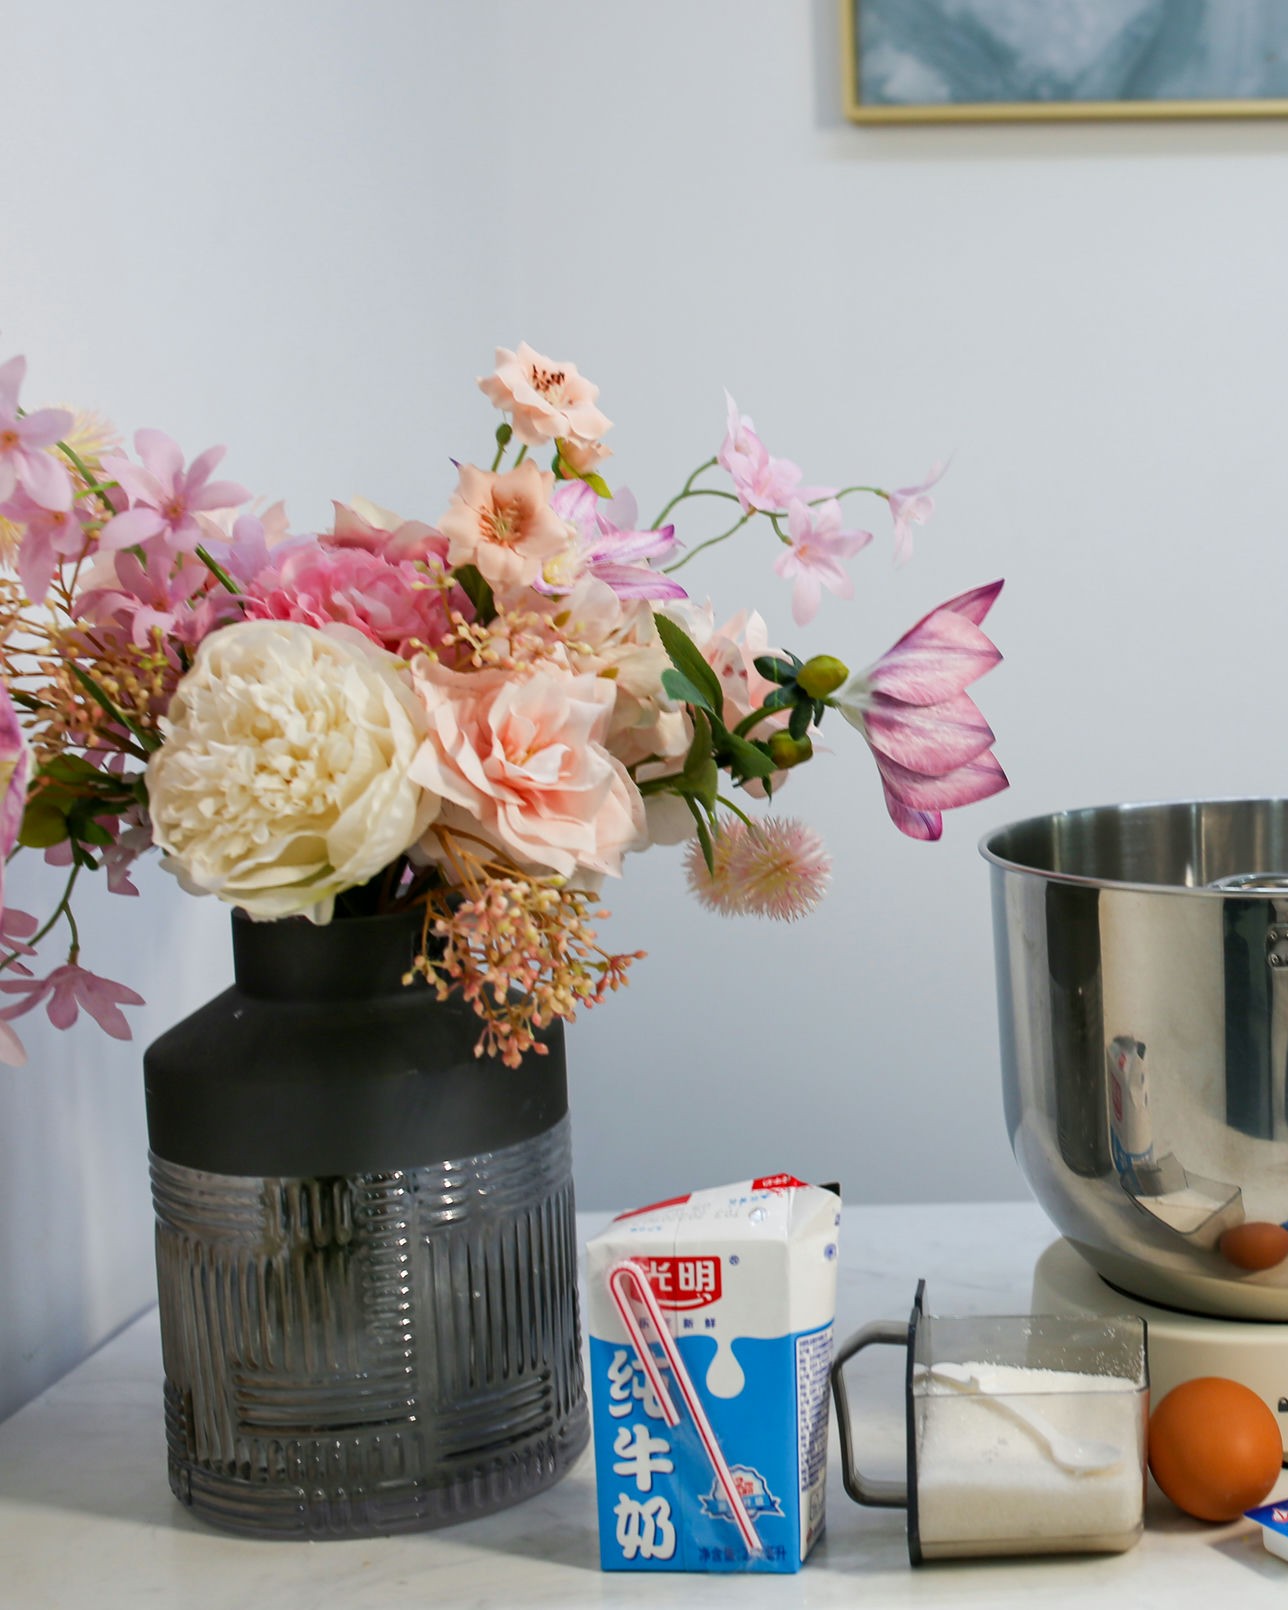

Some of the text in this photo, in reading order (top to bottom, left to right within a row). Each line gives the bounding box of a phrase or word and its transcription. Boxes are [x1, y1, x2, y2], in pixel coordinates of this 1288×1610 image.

[641, 1259, 717, 1292] 光明
[607, 1350, 677, 1561] 纯牛奶
